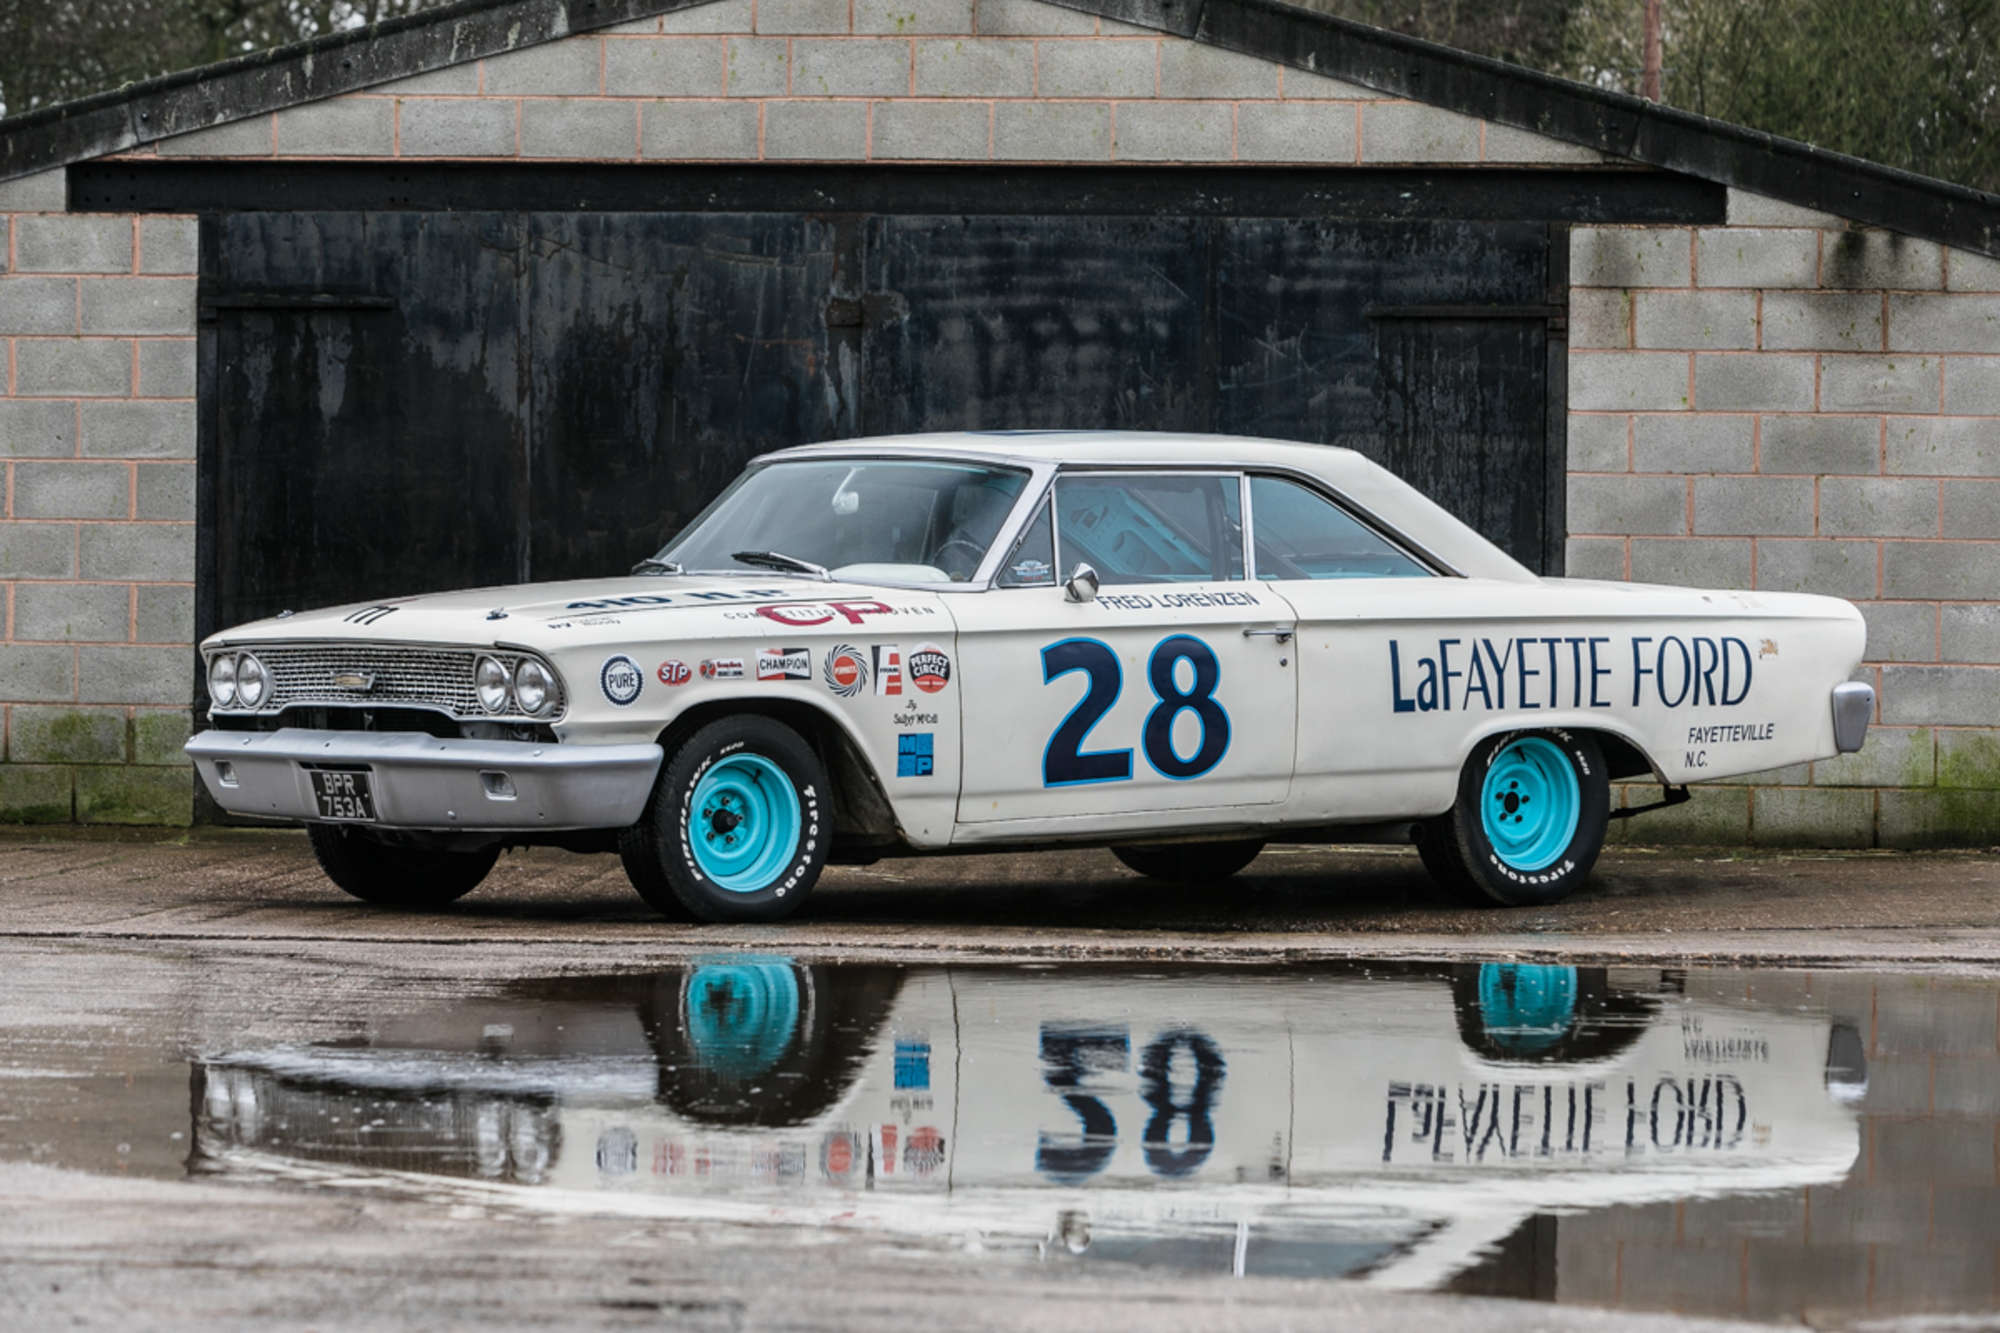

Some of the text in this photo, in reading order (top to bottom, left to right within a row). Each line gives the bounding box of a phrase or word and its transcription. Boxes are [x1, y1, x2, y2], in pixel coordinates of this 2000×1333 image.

[1096, 592, 1260, 610] FRED LORENZEN
[723, 607, 850, 620] COMETITIO
[758, 656, 809, 672] CHAMPION
[910, 654, 948, 668] PERFECT
[913, 664, 947, 678] CIRCLE
[608, 672, 636, 689] PURE
[660, 660, 689, 683] STP
[1388, 635, 1753, 714] LaFAYETTE FORD
[1039, 633, 1232, 788] 28
[1687, 723, 1775, 744] FAYETTEVILLE
[1684, 750, 1708, 769] N.C.
[322, 774, 357, 796] BPR
[322, 795, 367, 818] 753A
[679, 755, 712, 882] FIREHAWK
